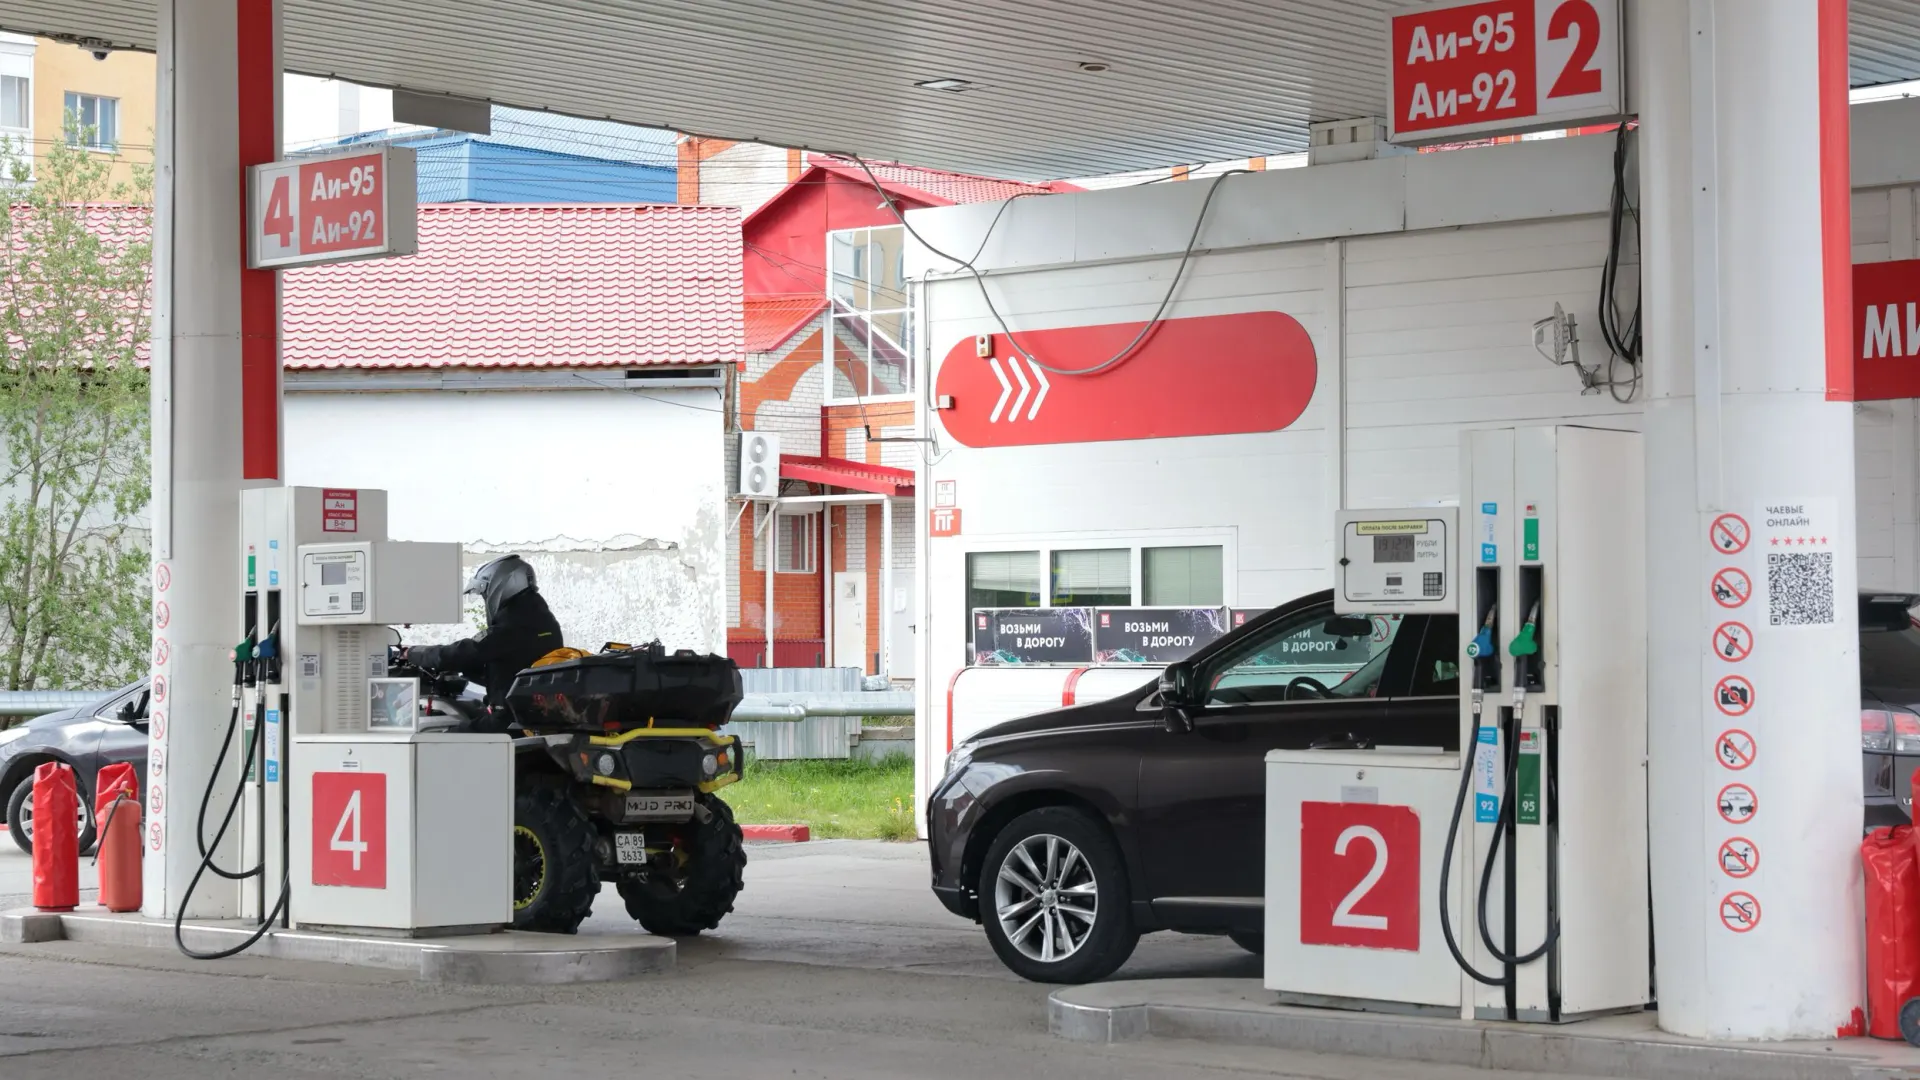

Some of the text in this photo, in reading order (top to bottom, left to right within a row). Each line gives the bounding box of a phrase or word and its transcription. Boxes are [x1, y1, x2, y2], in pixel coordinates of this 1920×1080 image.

[1406, 12, 1516, 65] Аи-95
[1546, 0, 1602, 99] 2
[1407, 69, 1517, 121] Аи-92
[310, 165, 375, 202] Аи-95
[263, 175, 294, 247] 4
[311, 209, 376, 245] Аи-92
[1765, 505, 1804, 514] ЧАЕВЫЕ
[1766, 515, 1810, 527] ОНЛАЙН
[1000, 623, 1041, 635] ВОЗЬМИ
[1125, 622, 1169, 633] ВОЗЬМИ
[1017, 637, 1066, 649] В ДОРОГУ
[1143, 635, 1195, 647] В ДОРОГУ
[1282, 643, 1289, 653] В
[627, 802, 659, 811] MUD
[1481, 801, 1494, 811] 92
[1522, 801, 1535, 812] 95
[330, 789, 368, 871] 4
[632, 836, 643, 846] 89
[621, 850, 643, 861] 3633
[1332, 824, 1389, 931] 2
